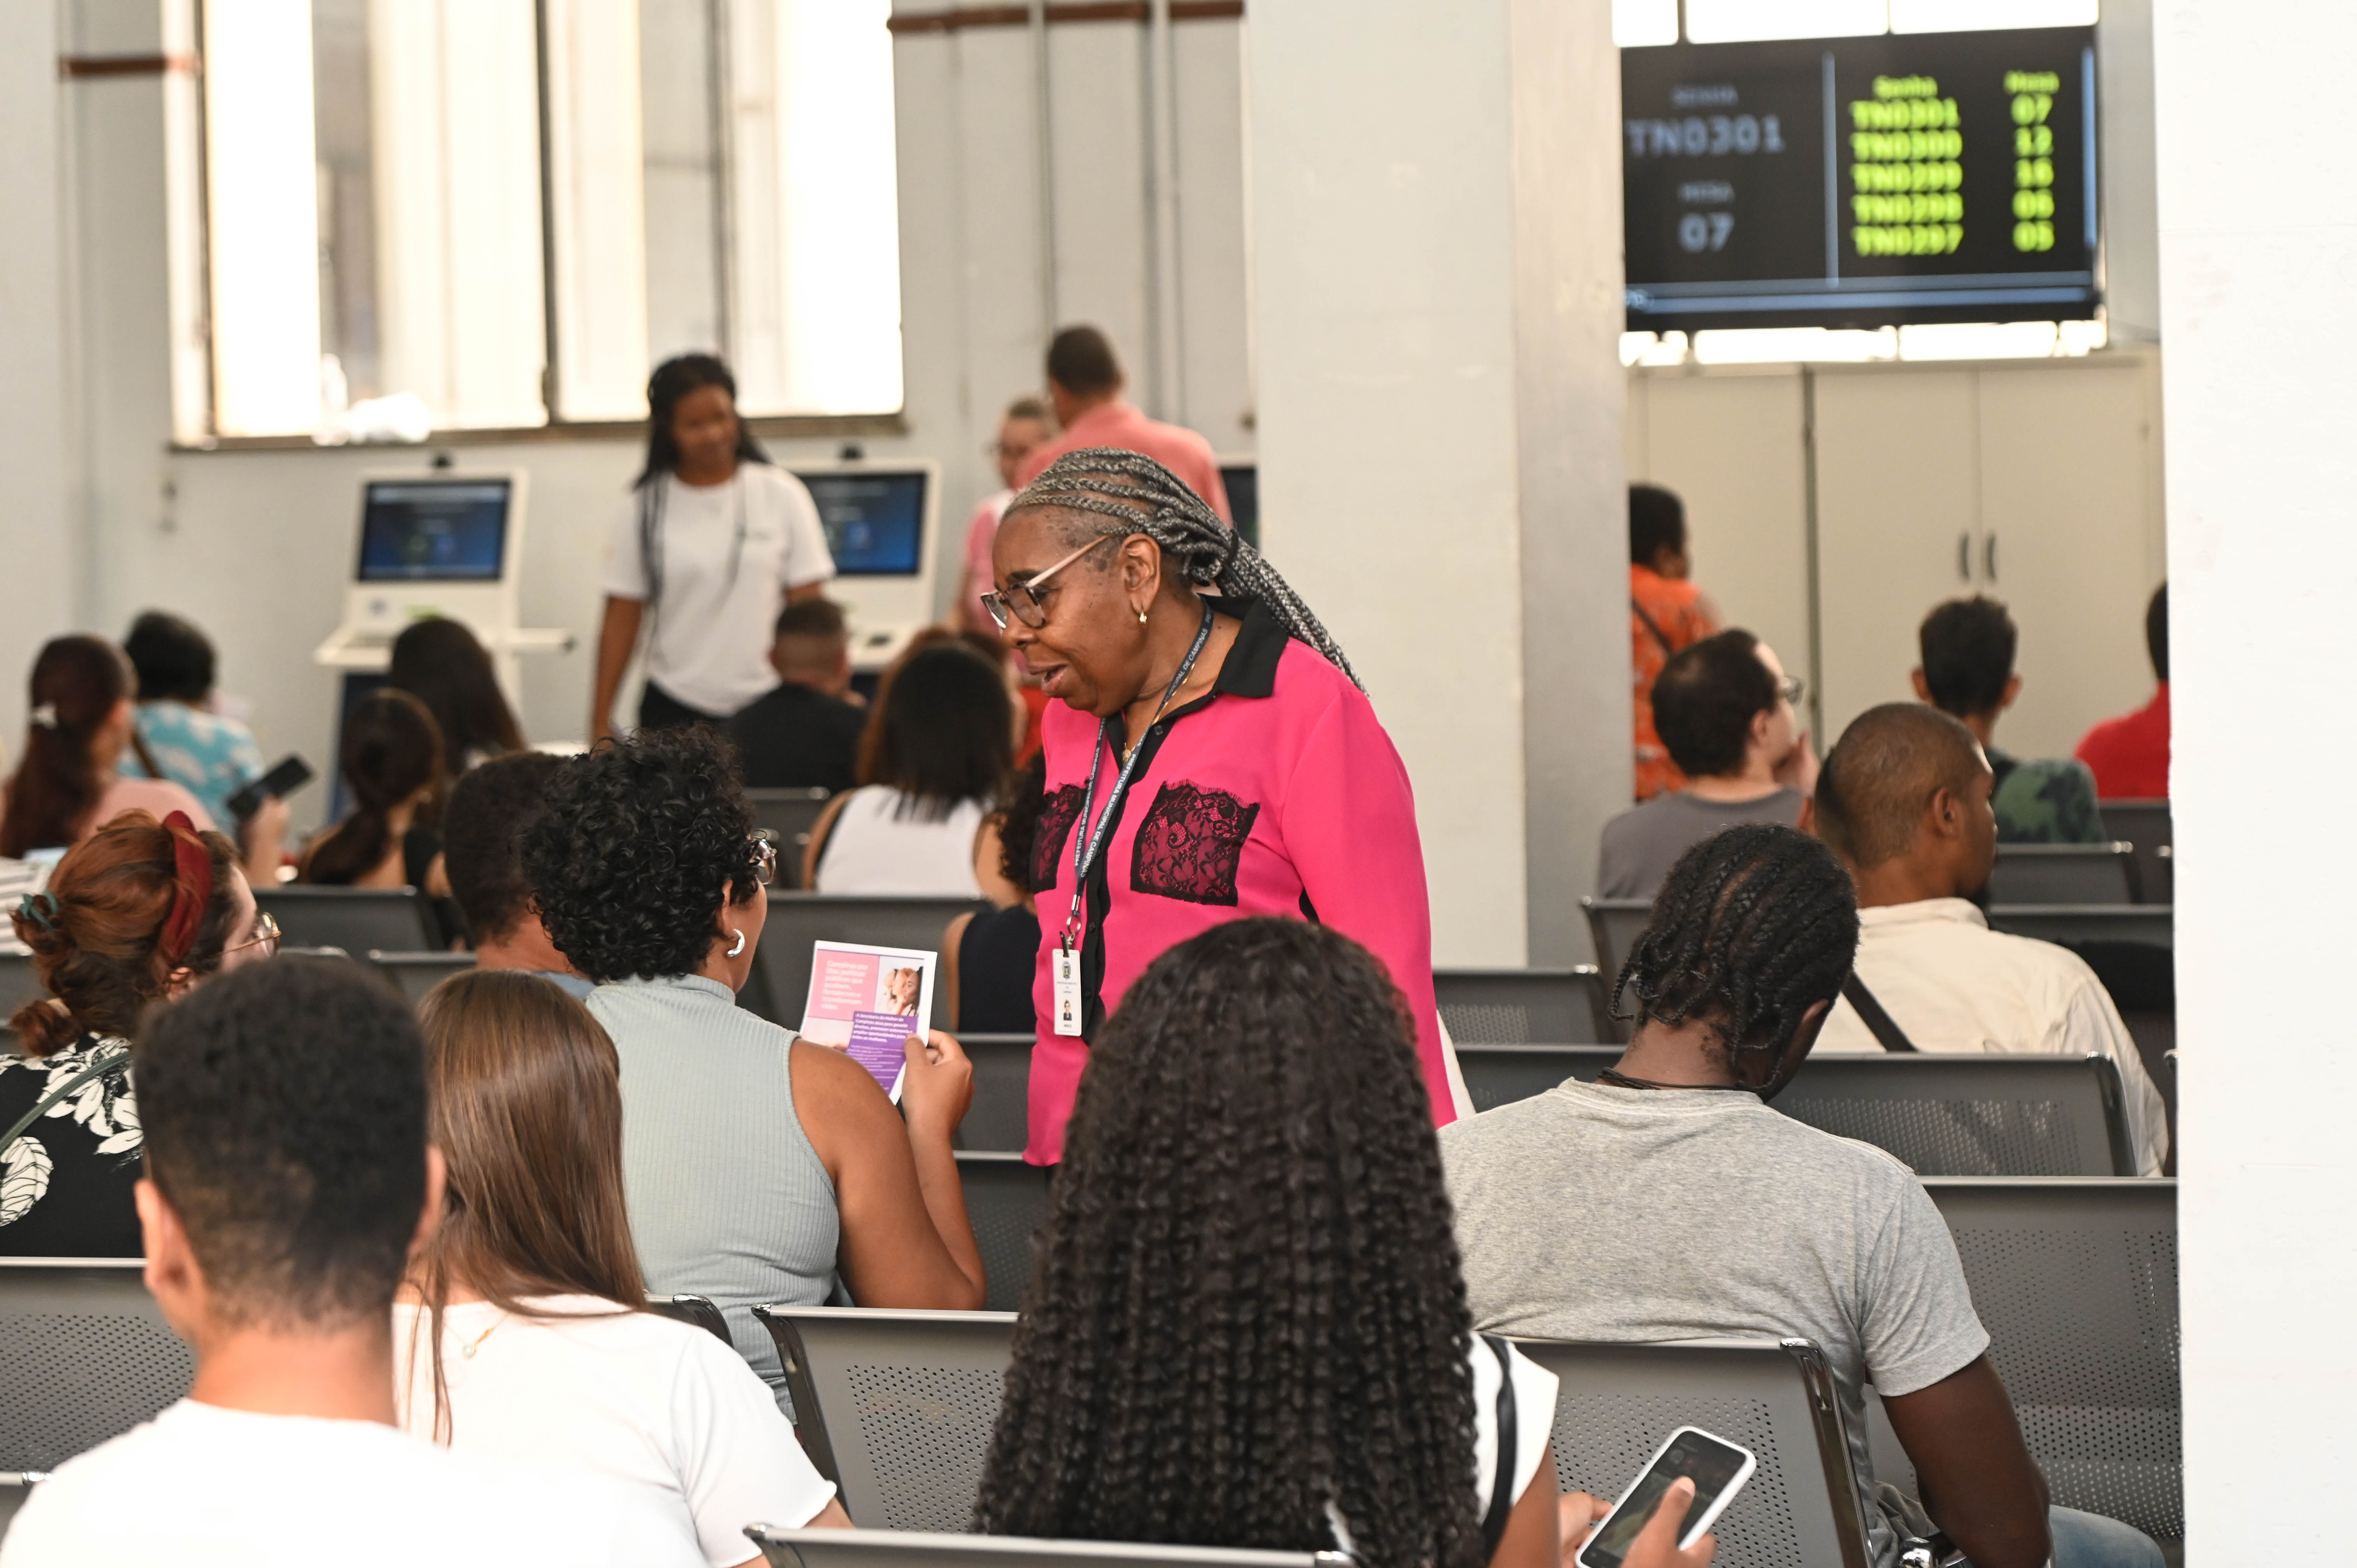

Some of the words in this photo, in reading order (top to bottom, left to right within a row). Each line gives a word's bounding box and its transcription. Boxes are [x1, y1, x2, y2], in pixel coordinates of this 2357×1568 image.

[2011, 94, 2052, 125] 07
[1626, 115, 1784, 157] TN0301
[1679, 212, 1733, 252] 07
[1183, 659, 1191, 670] DE
[1189, 628, 1208, 661] CAMPINAS
[1113, 754, 1136, 794] PREFEITURA
[1098, 794, 1117, 830] MUNICIPAL
[1075, 825, 1085, 867] PREFEITURA
[1093, 831, 1101, 841] DE
[1081, 841, 1097, 878] CAMPINAS
